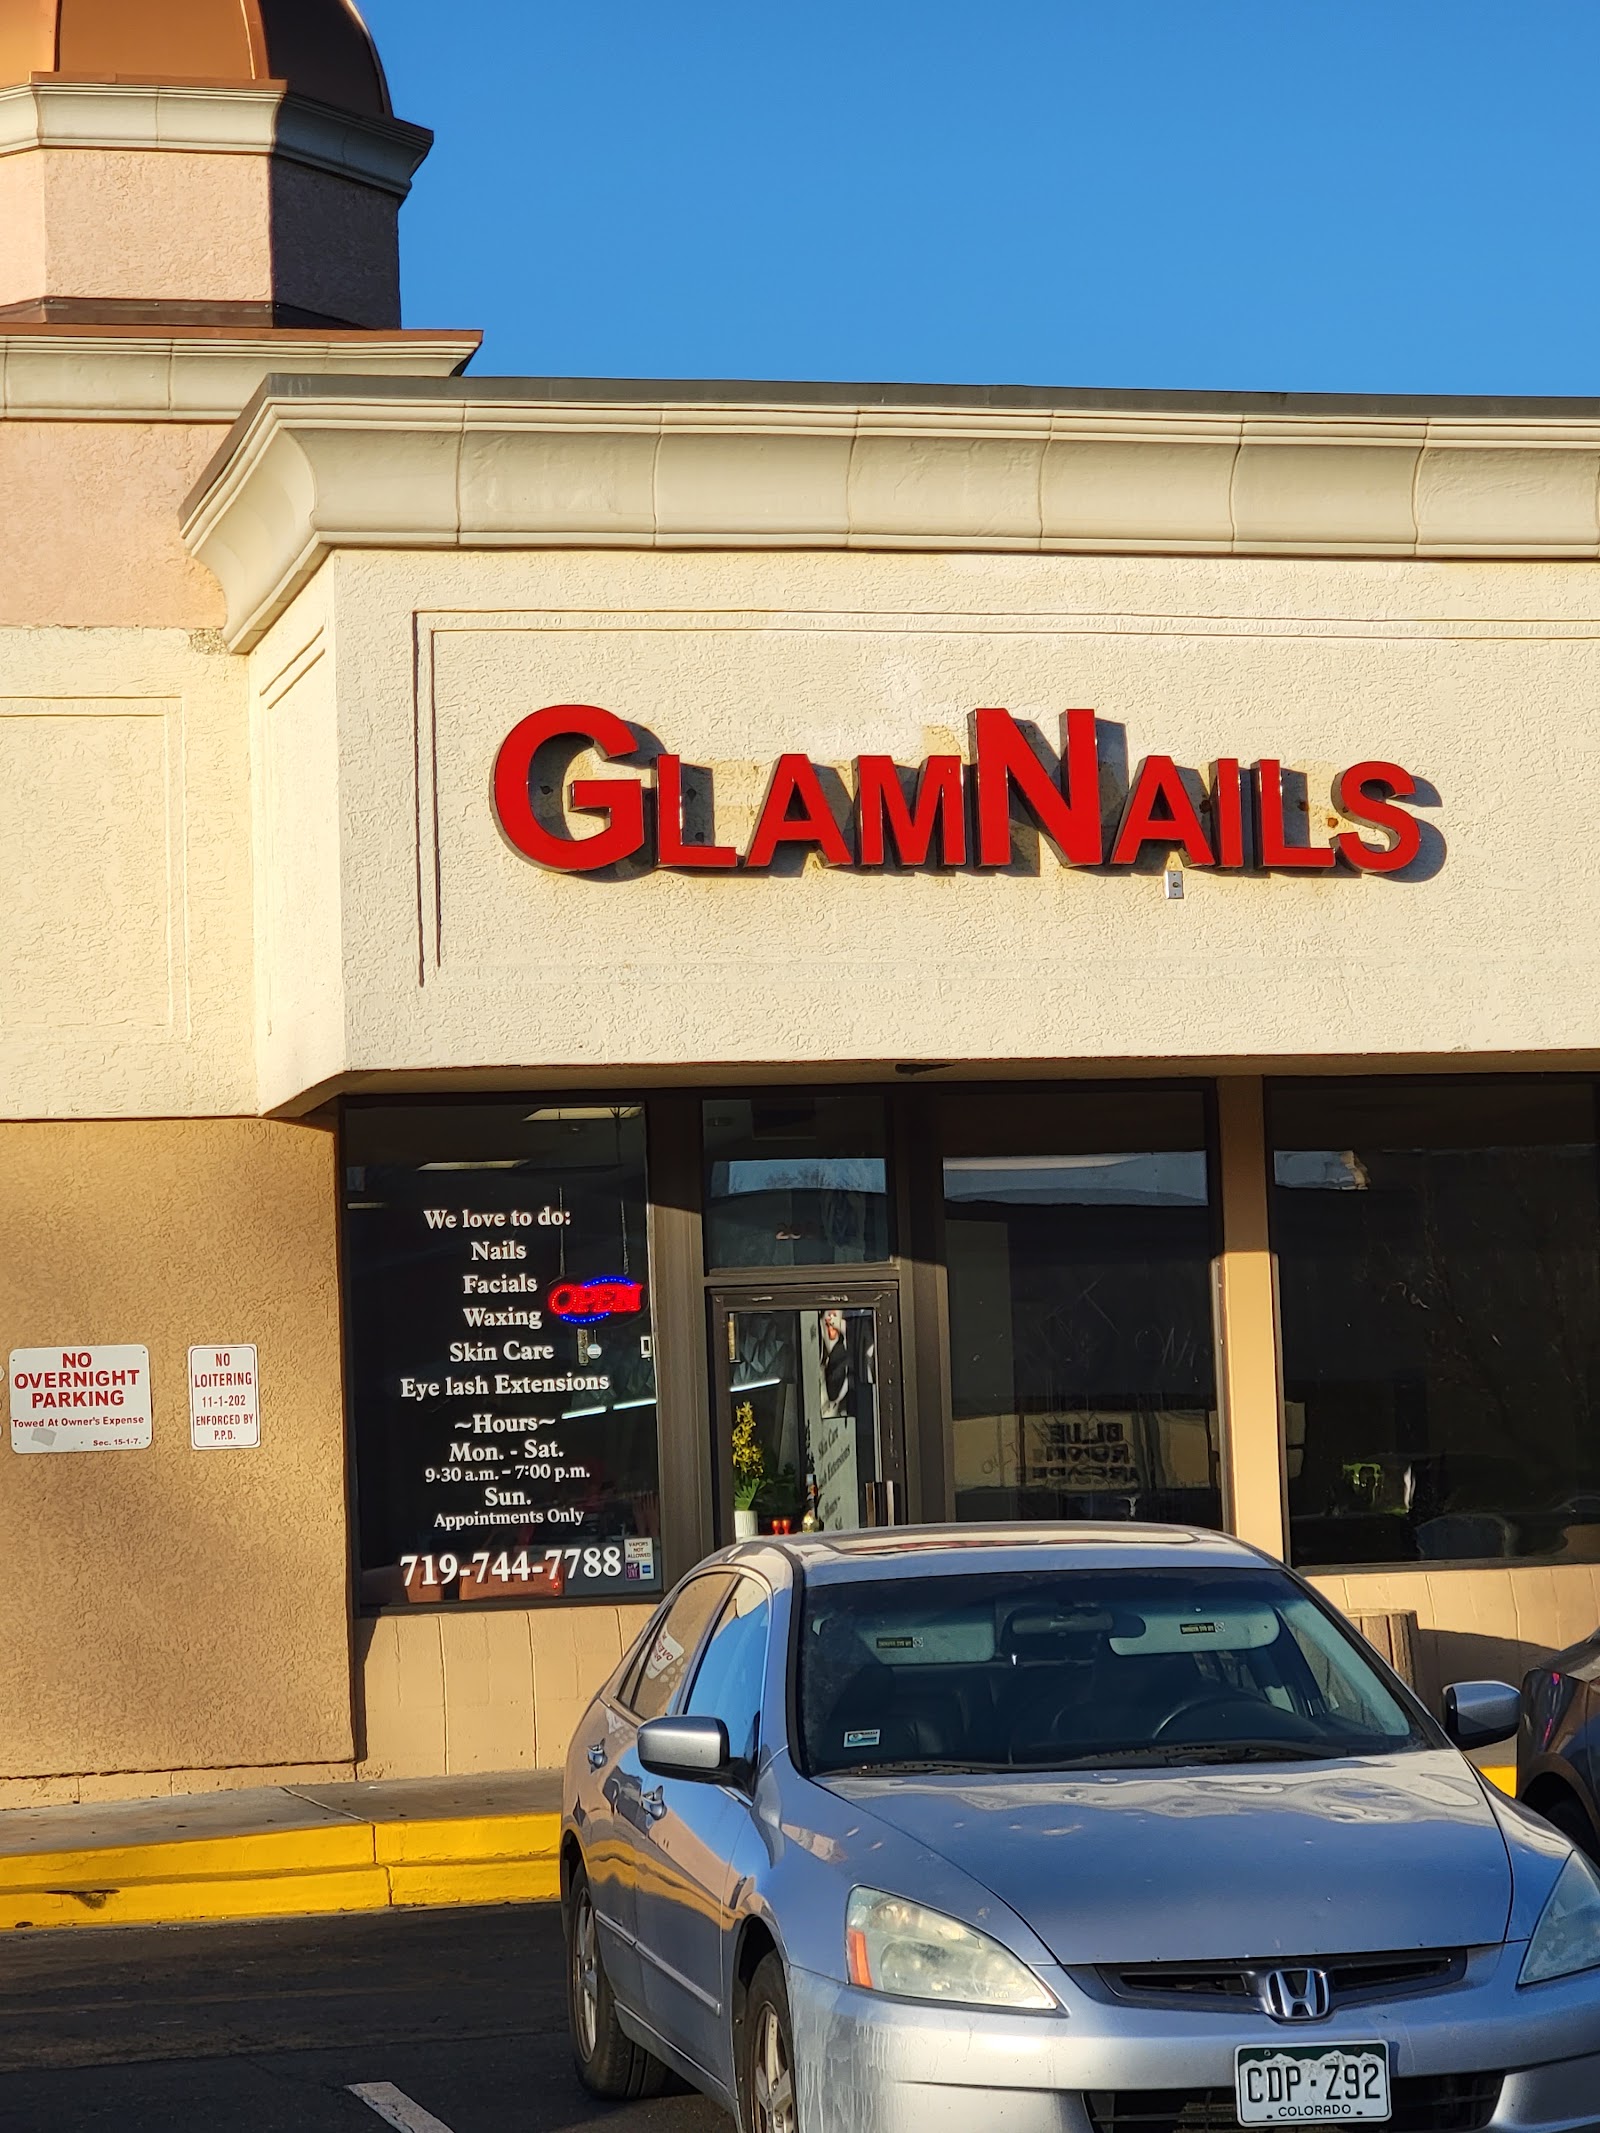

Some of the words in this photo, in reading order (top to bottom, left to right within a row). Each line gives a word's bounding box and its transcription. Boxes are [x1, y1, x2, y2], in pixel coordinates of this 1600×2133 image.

[424, 1210, 456, 1229] We
[462, 1208, 505, 1228] love
[511, 1210, 532, 1226] to
[538, 1206, 571, 1225] do:
[471, 1241, 527, 1260] Nails
[463, 1273, 538, 1294] Facials
[548, 1284, 643, 1314] OPEN
[463, 1307, 542, 1329] Waxing
[62, 1352, 92, 1368] NO
[216, 1353, 230, 1366] NO
[449, 1342, 498, 1362] Skin
[503, 1340, 554, 1360] Care
[14, 1370, 139, 1389] OVERNIGHT
[195, 1372, 252, 1387] LOITERING
[401, 1378, 440, 1401] Eye
[445, 1375, 489, 1396] lash
[495, 1372, 609, 1395] Extensions
[32, 1390, 124, 1408] PARKING
[202, 1395, 245, 1408] 11-1-202
[13, 1419, 44, 1428] Towed
[61, 1417, 100, 1426] Owner's
[103, 1416, 144, 1426] Expense
[196, 1414, 240, 1426] ENFORCED
[244, 1414, 253, 1424] BY
[214, 1430, 236, 1440] P.P.D.
[449, 1443, 504, 1463] Mon.
[524, 1439, 564, 1458] Sat.
[464, 1468, 499, 1481] a.m.
[515, 1465, 550, 1479] 7:00
[555, 1466, 590, 1482] p.m.
[485, 1487, 531, 1507] Sun.
[433, 1511, 543, 1531] Appointments
[547, 1508, 584, 1526] Only
[399, 1546, 622, 1587] 719-744-7788
[1279, 2104, 1351, 2116] COLORADO
